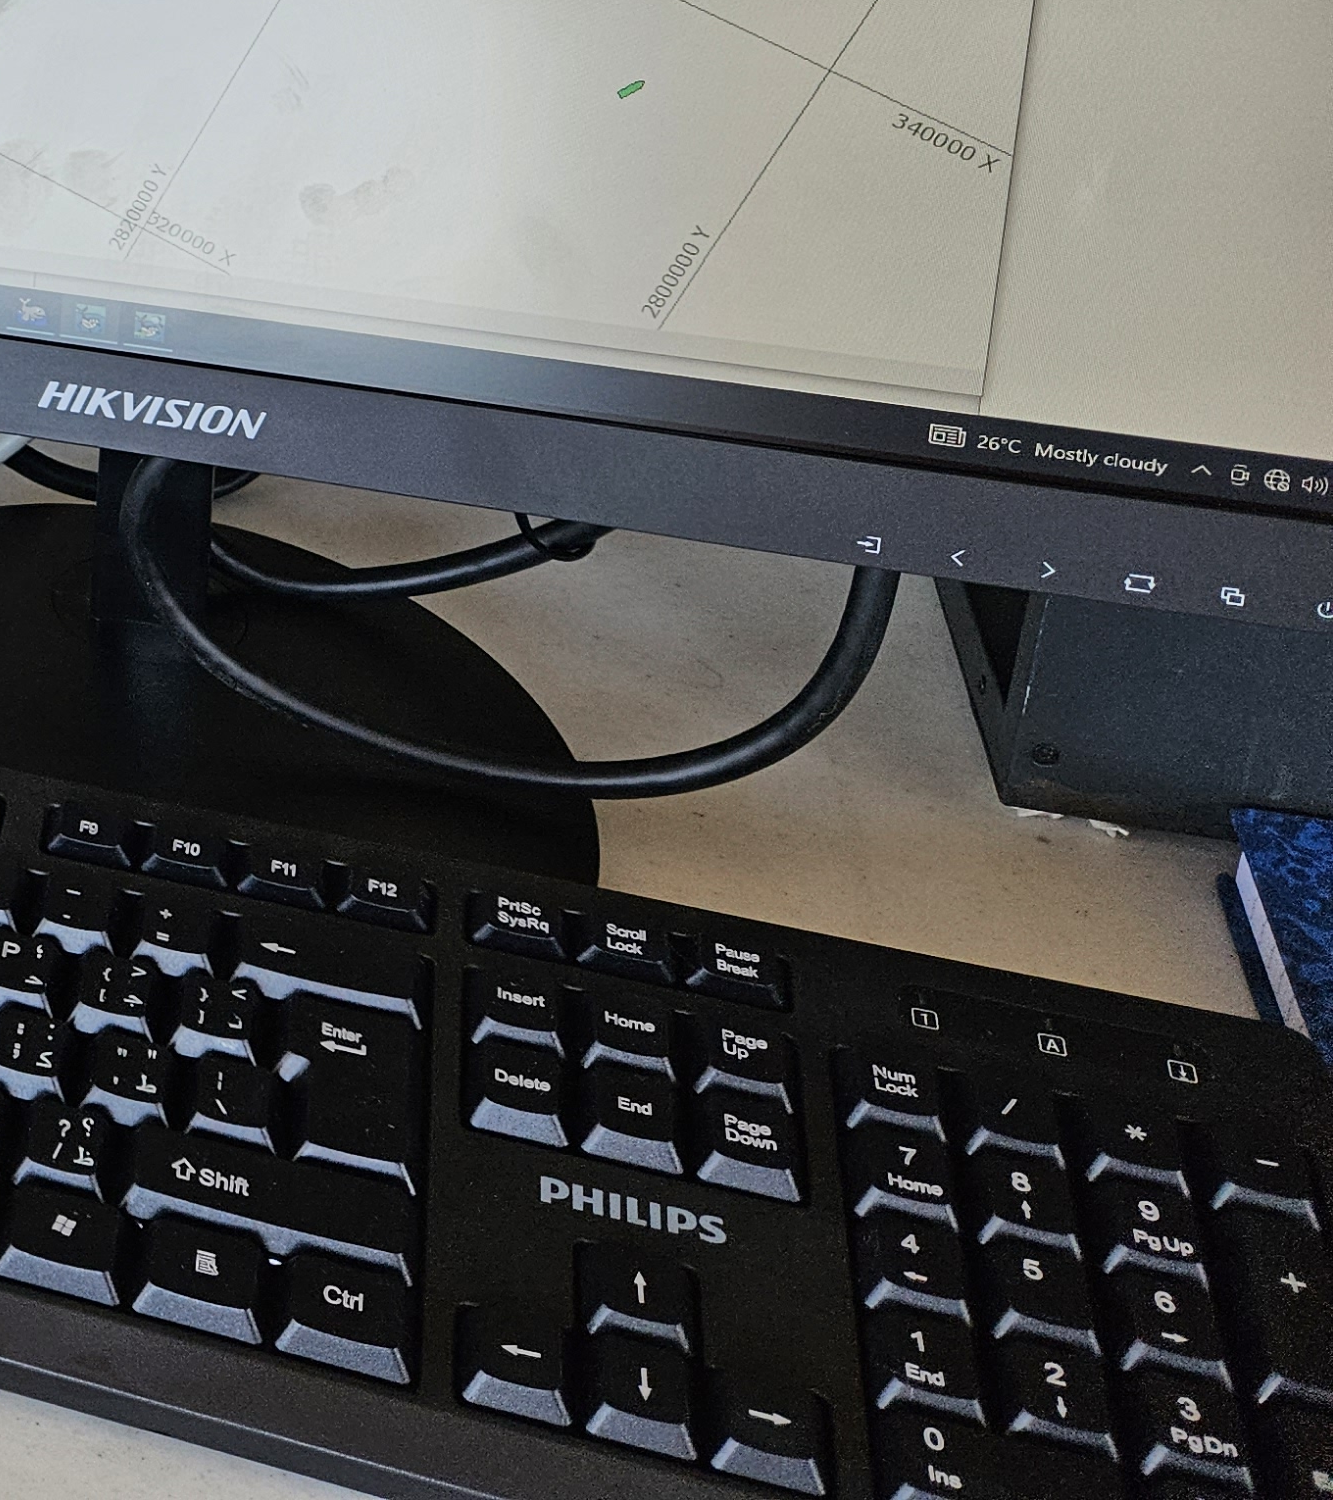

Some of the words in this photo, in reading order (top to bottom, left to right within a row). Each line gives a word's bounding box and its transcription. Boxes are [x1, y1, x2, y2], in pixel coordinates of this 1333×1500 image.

[890, 112, 976, 162] 340000
[977, 153, 1001, 174] X
[641, 241, 701, 320] 2800000
[690, 225, 711, 242] Y
[38, 380, 267, 439] HIKVISION
[976, 432, 1022, 455] 26°C
[1035, 442, 1099, 468] Mostly
[1103, 451, 1169, 477] cloudy
[171, 838, 201, 857] F10
[367, 878, 398, 898] F12
[497, 896, 542, 917] PrtSc
[497, 910, 550, 934] SysRq
[496, 986, 546, 1008] Insert
[321, 1021, 364, 1044] Enter
[604, 1010, 656, 1033] Home
[494, 1068, 552, 1092] Delete
[617, 1095, 653, 1117] End
[198, 1168, 250, 1197] Shift
[540, 1175, 728, 1245] PHILIPS
[323, 1284, 364, 1312] Ctrl
